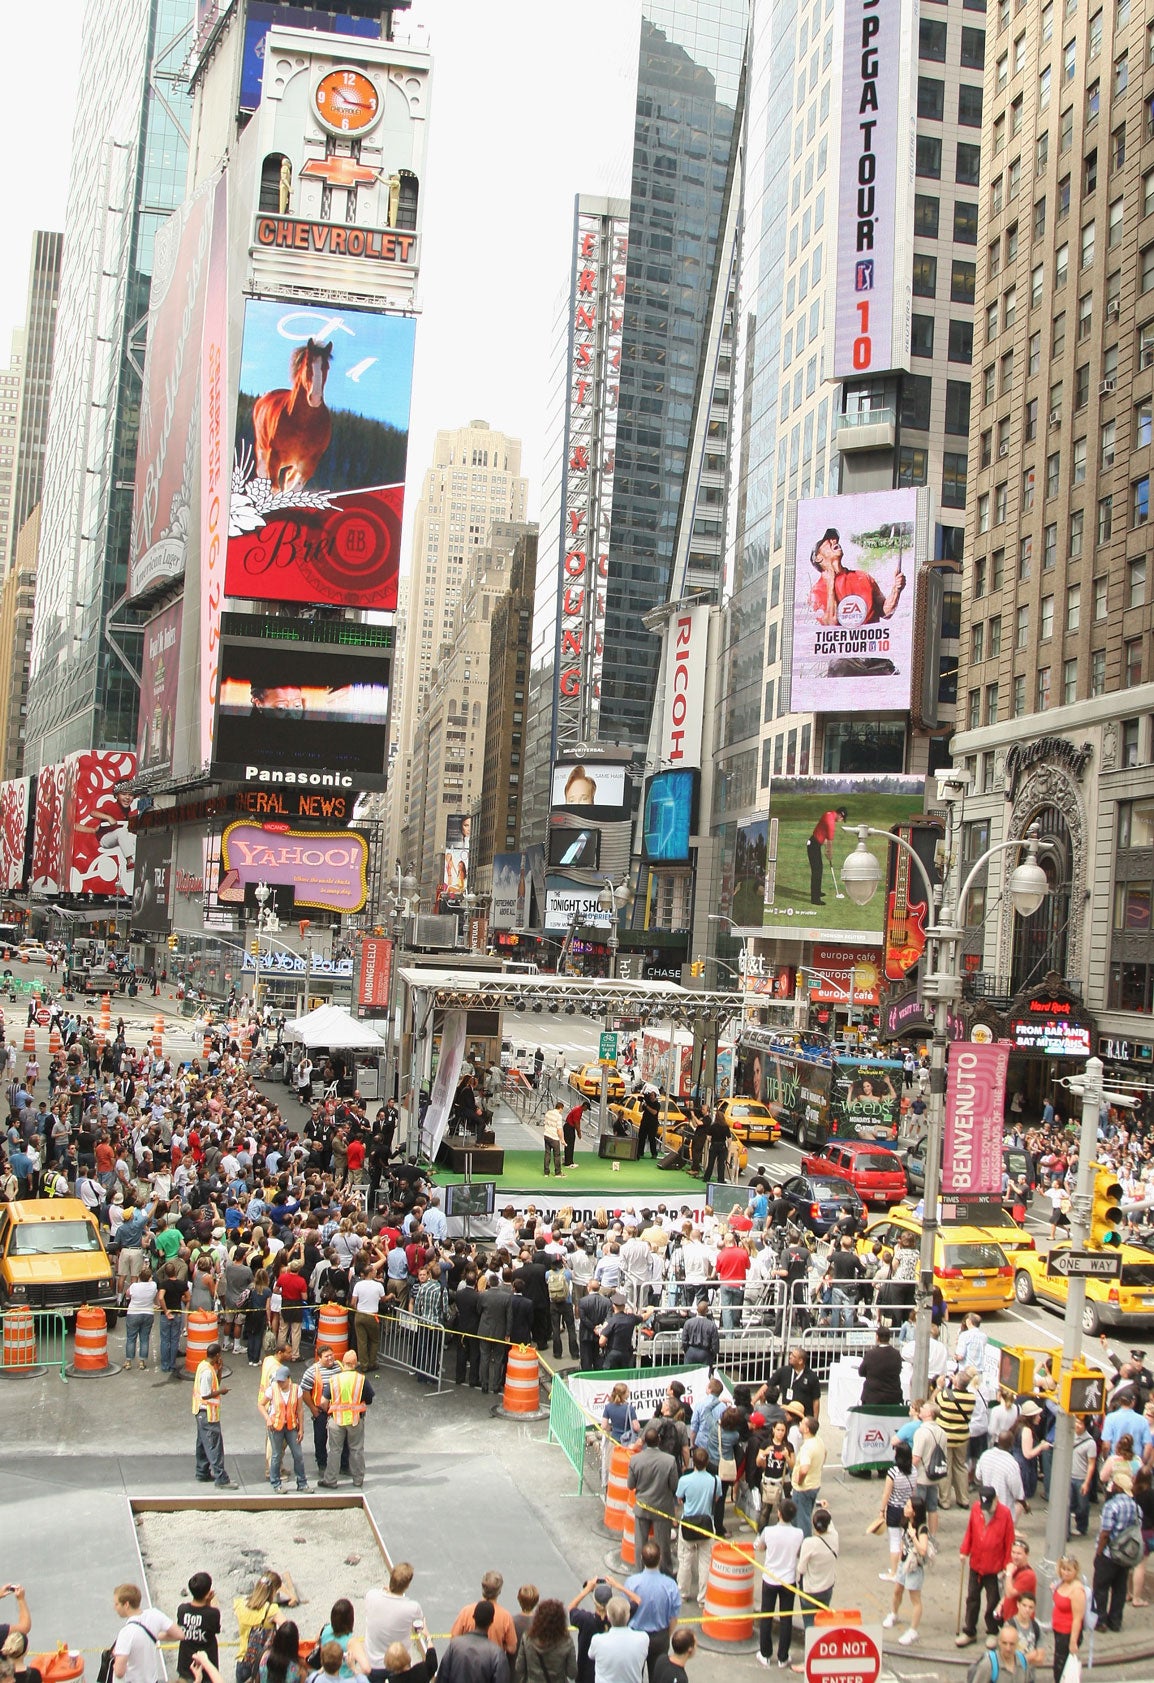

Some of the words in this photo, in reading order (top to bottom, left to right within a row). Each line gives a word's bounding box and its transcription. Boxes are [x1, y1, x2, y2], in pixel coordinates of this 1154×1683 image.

[859, 15, 880, 114] PGA
[342, 72, 356, 86] 12
[317, 91, 326, 104] 9
[331, 105, 362, 115] CHEVROLET
[341, 119, 350, 130] 6
[857, 119, 878, 252] TOUR
[258, 218, 414, 262] CHEVROLET
[576, 233, 597, 405] ERNST
[570, 445, 590, 471] &
[162, 548, 180, 569] Lager
[560, 510, 587, 696] YOUNG
[842, 602, 861, 614] EA
[816, 630, 847, 643] TIGER
[849, 628, 890, 641] WOODS
[814, 642, 837, 655] PGA
[838, 641, 867, 654] TOUR
[878, 640, 890, 652] 10
[670, 616, 692, 760] RICOH
[245, 766, 353, 787] Panasonic
[299, 795, 346, 818] NEWS
[550, 899, 581, 912] TONIGHT
[583, 900, 612, 913] SHO
[820, 951, 853, 961] europa
[856, 952, 876, 961] café
[363, 943, 377, 1003] UMBINGELELO
[648, 967, 681, 978] CHASE
[854, 990, 874, 1000] café
[1030, 1001, 1051, 1012] Hard
[1051, 1002, 1071, 1014] Rock
[1016, 1025, 1042, 1036] FROM
[1044, 1026, 1064, 1036] BAR
[1064, 1028, 1086, 1037] AND
[1016, 1037, 1036, 1047] BAT
[995, 1053, 1006, 1087] WORLD
[993, 1089, 1003, 1108] THE
[953, 1052, 978, 1188] BENVENUTO
[993, 1110, 1001, 1123] OF
[982, 1117, 991, 1154] SQUARE
[991, 1125, 1001, 1187] CROSSROADS
[981, 1157, 990, 1187] TIMES
[1059, 1258, 1081, 1270] ONE
[1090, 1260, 1113, 1271] WAY
[629, 1389, 653, 1400] IGER
[864, 1429, 885, 1442] EA
[768, 1458, 783, 1468] NY
[731, 1566, 754, 1575] OPERAT
[819, 1642, 837, 1656] DO
[842, 1641, 868, 1655] NOT
